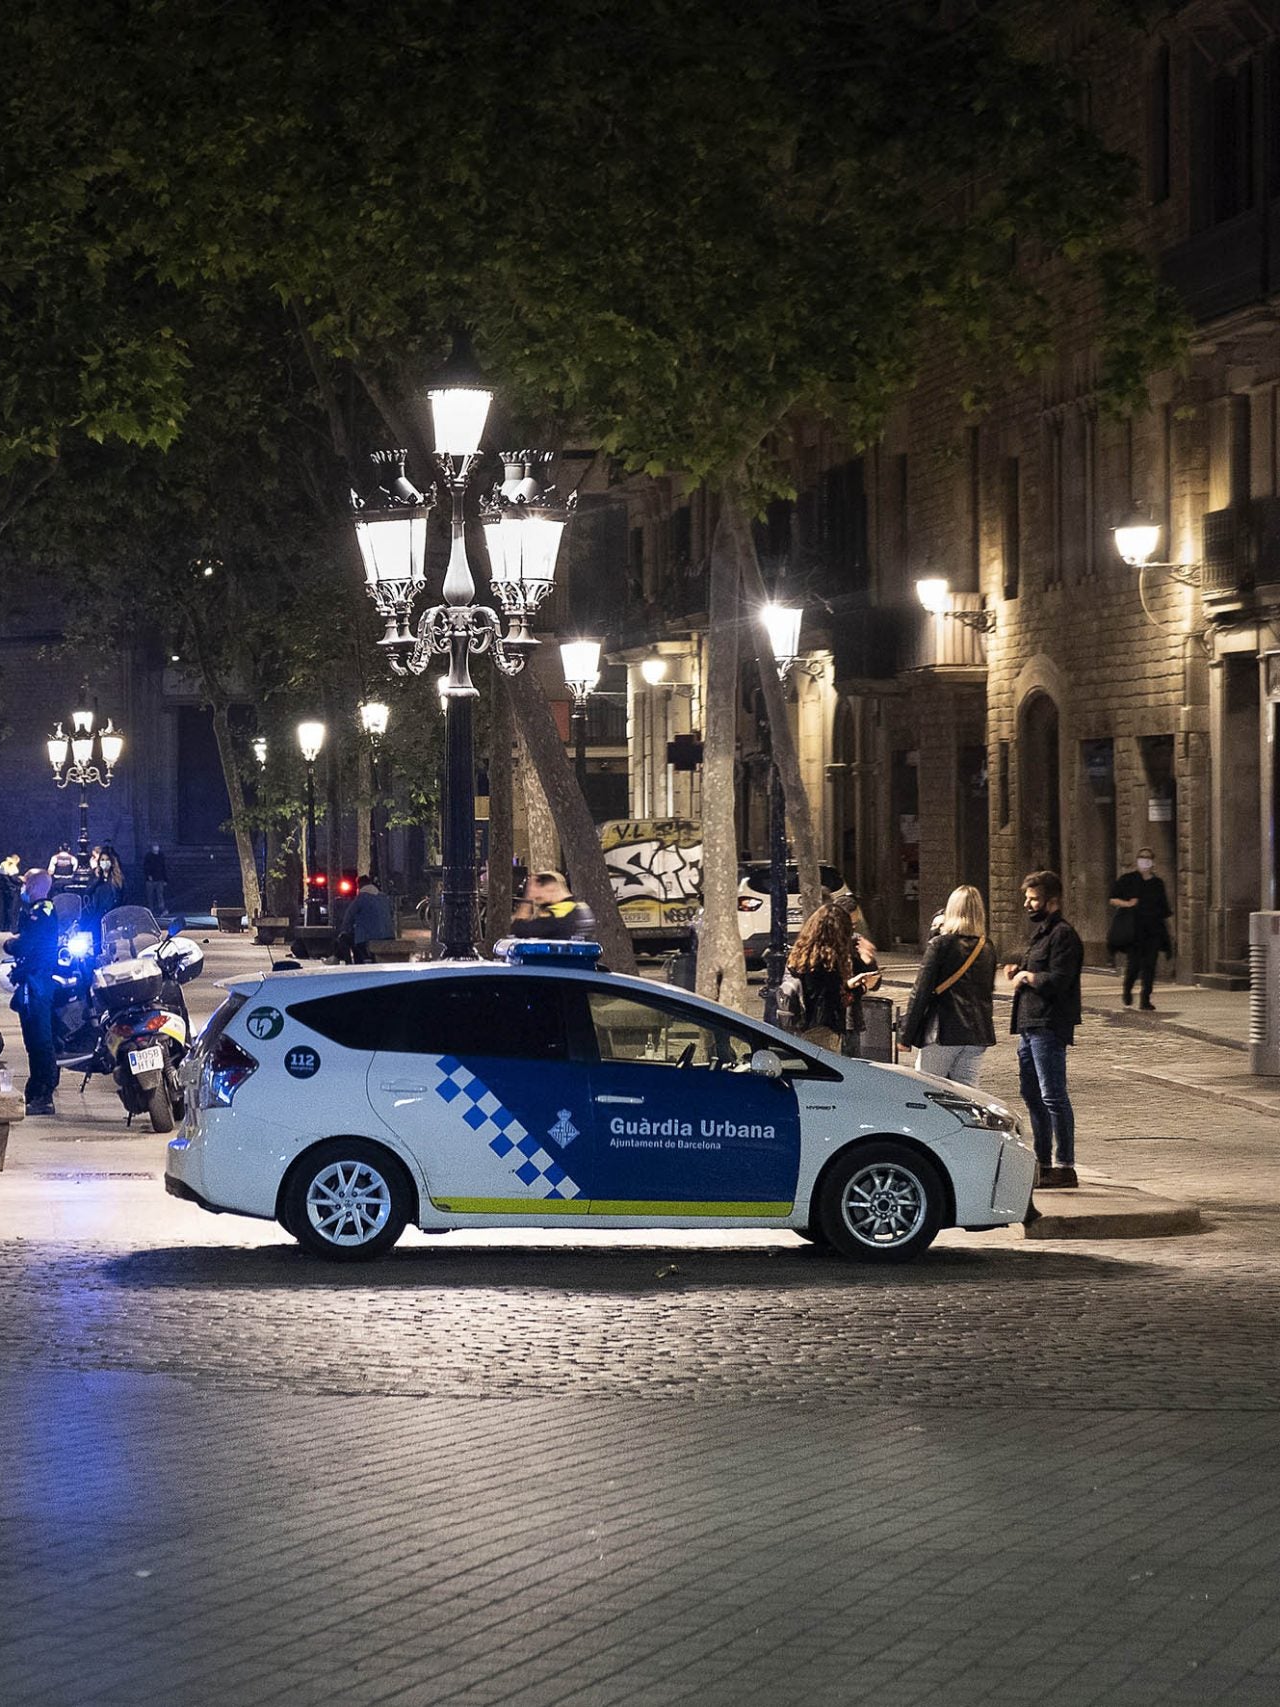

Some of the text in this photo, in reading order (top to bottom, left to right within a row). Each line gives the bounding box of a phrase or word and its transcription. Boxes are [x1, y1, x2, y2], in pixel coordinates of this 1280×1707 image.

[291, 1053, 314, 1067] 112
[610, 1117, 776, 1139] Guàrdia Urbana
[609, 1138, 721, 1150] Ajuntament de Barcelona
